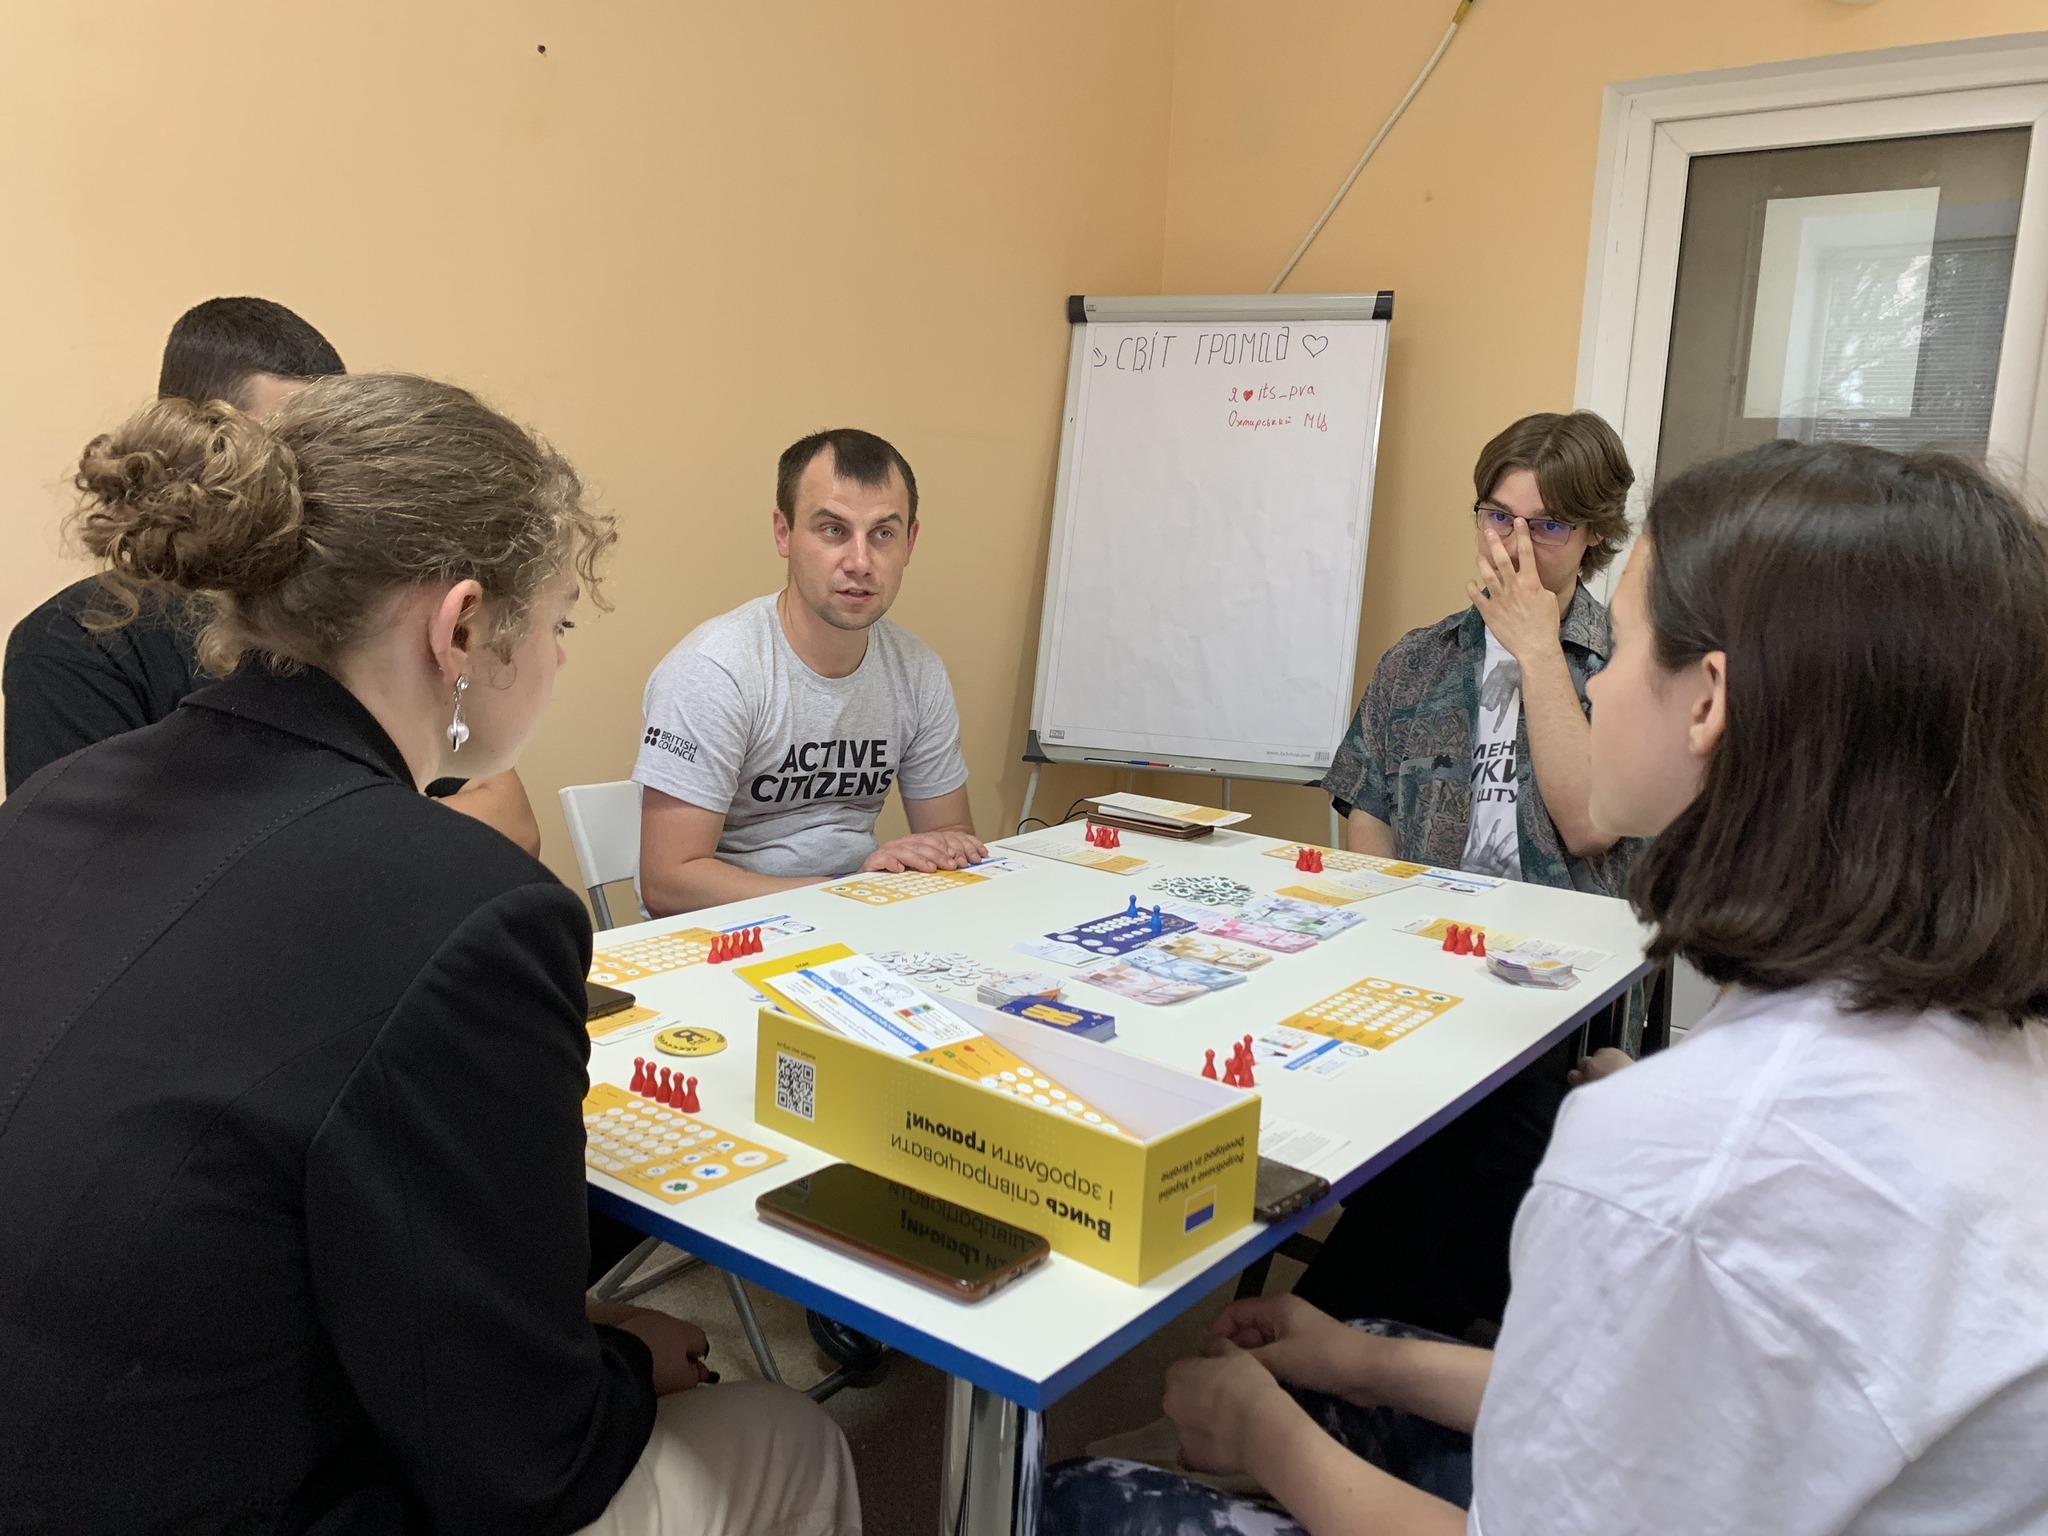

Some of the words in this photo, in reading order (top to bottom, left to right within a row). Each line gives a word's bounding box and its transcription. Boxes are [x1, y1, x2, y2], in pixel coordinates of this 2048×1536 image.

[1116, 331, 1178, 373] СВІТ
[657, 739, 696, 764] COUNCIL
[660, 730, 698, 754] BRITISH
[777, 739, 888, 774] ACTIVE
[750, 768, 895, 802] CITIZENS
[906, 1110, 986, 1154] граючи!
[891, 1133, 1040, 1207] співпрацювати
[991, 1143, 1103, 1200] заробляти
[1045, 1197, 1111, 1242] Вчись
